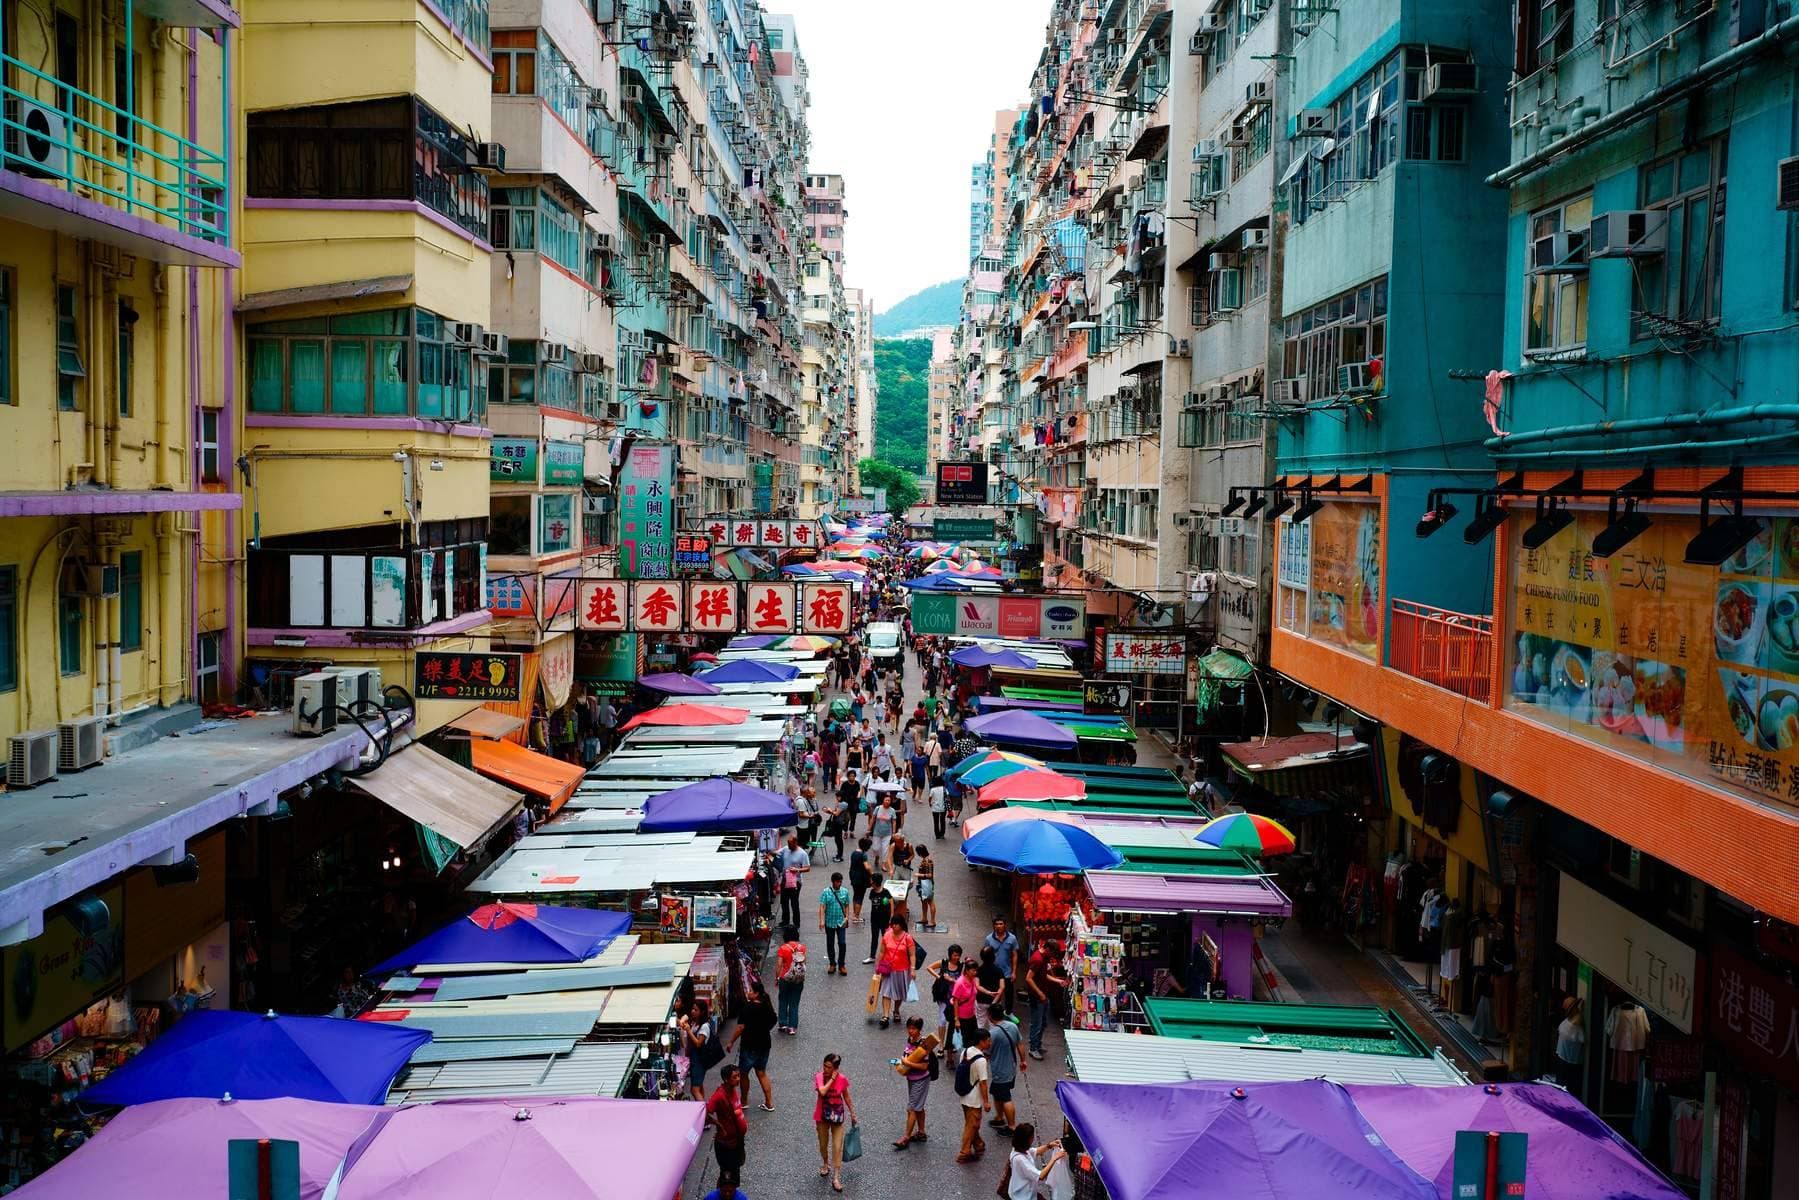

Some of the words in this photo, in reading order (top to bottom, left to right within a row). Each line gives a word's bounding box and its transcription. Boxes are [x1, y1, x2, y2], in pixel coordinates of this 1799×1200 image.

[1619, 553, 1667, 593] 三文治
[1579, 591, 1600, 607] FOOD
[961, 620, 993, 629] Wacoal
[420, 685, 439, 695] 1/F
[458, 686, 486, 697] 2214
[488, 687, 517, 698] 9995
